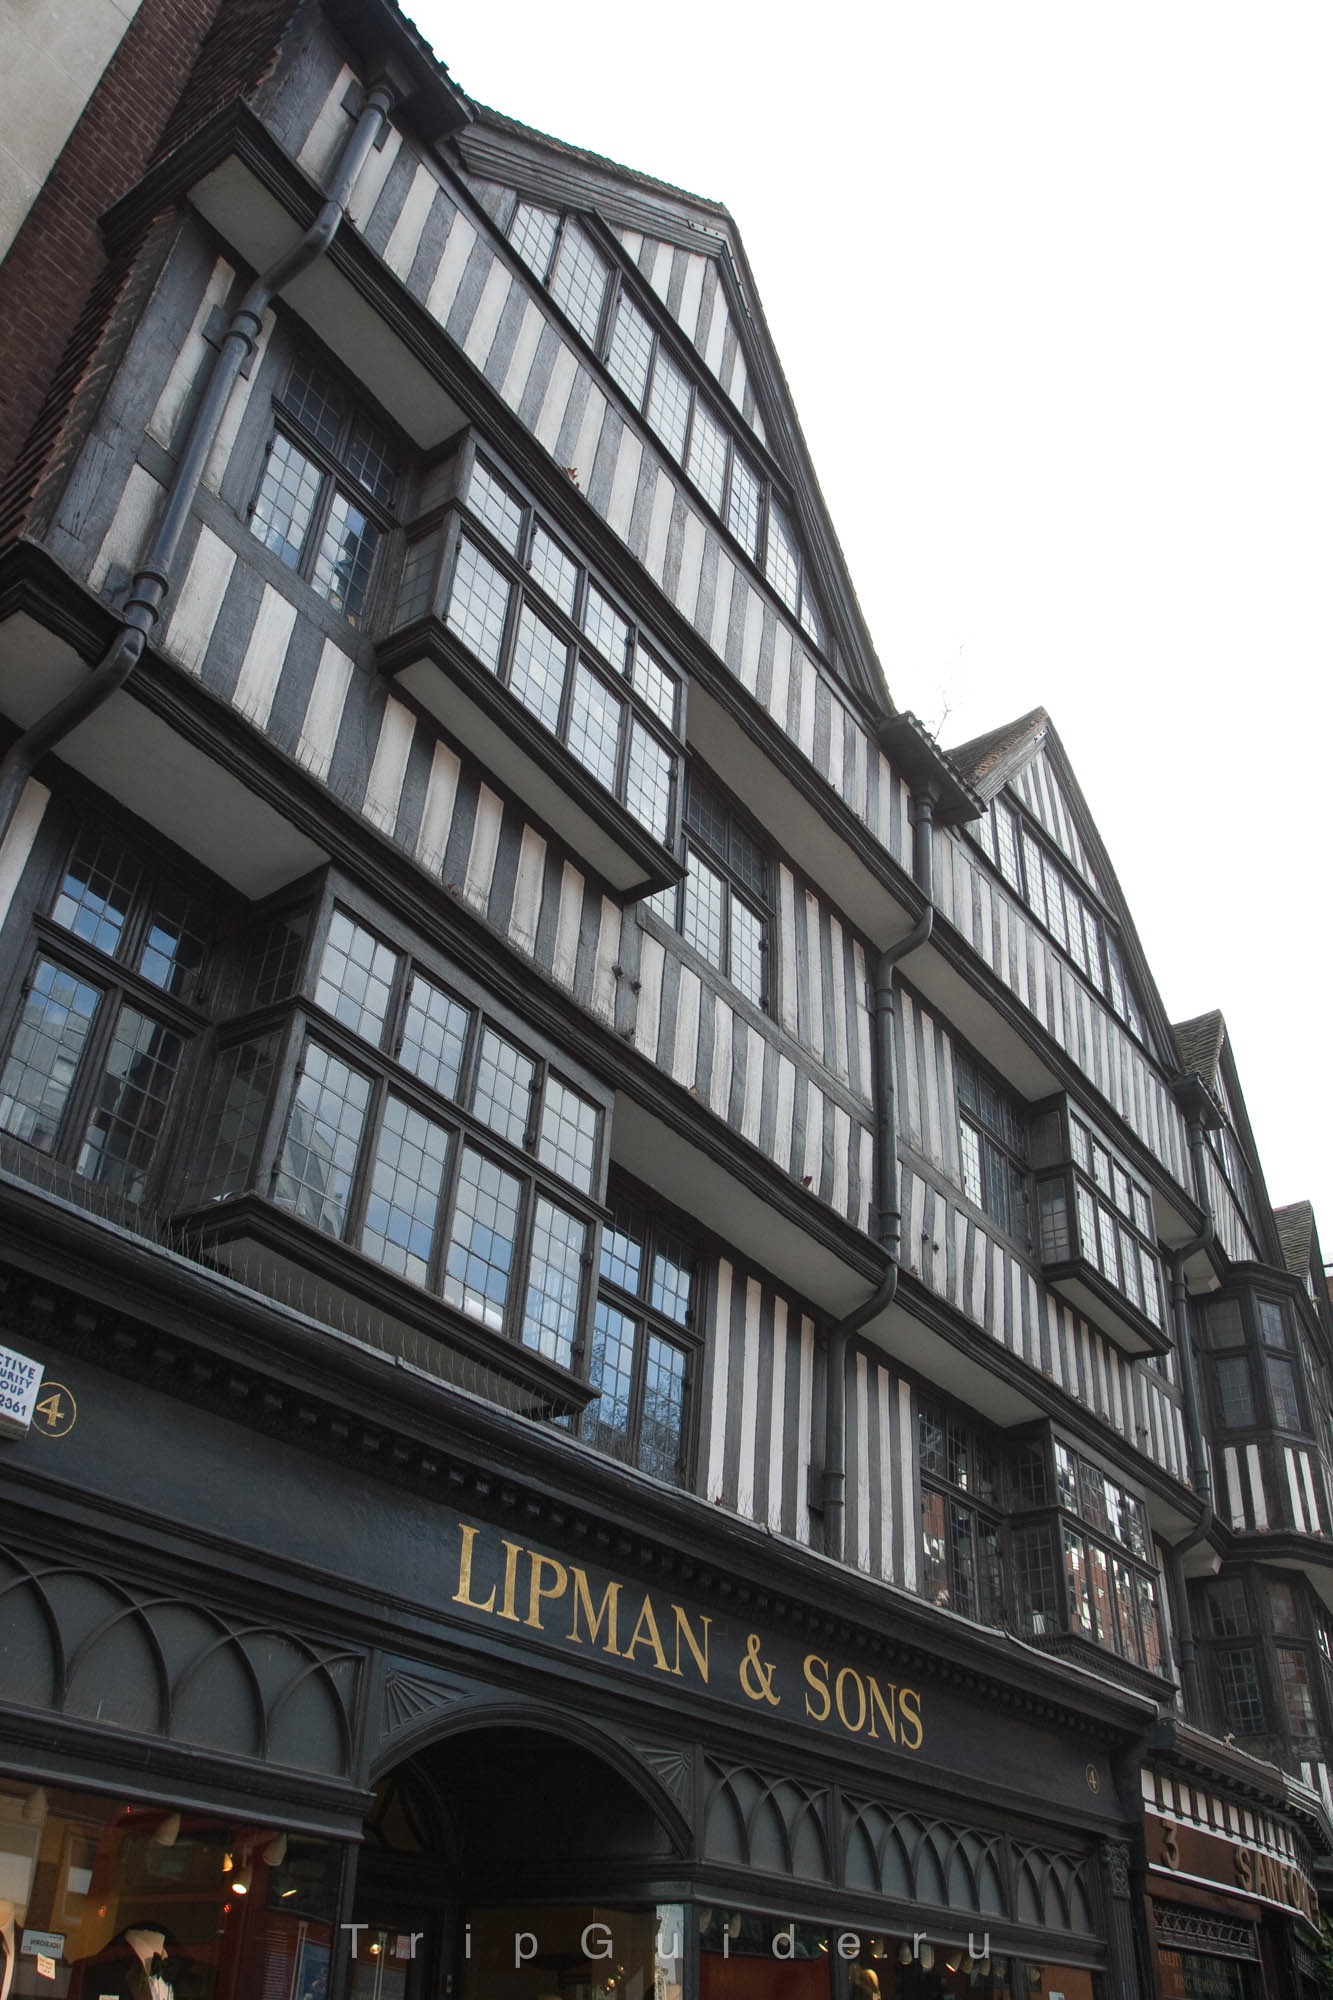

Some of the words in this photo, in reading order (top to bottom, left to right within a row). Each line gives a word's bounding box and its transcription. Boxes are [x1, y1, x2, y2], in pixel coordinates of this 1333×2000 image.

[36, 1393, 64, 1427] 4
[451, 1523, 712, 1684] LIPMAN
[738, 1633, 781, 1706] &
[803, 1653, 924, 1750] SONS
[1160, 1819, 1180, 1870] 3
